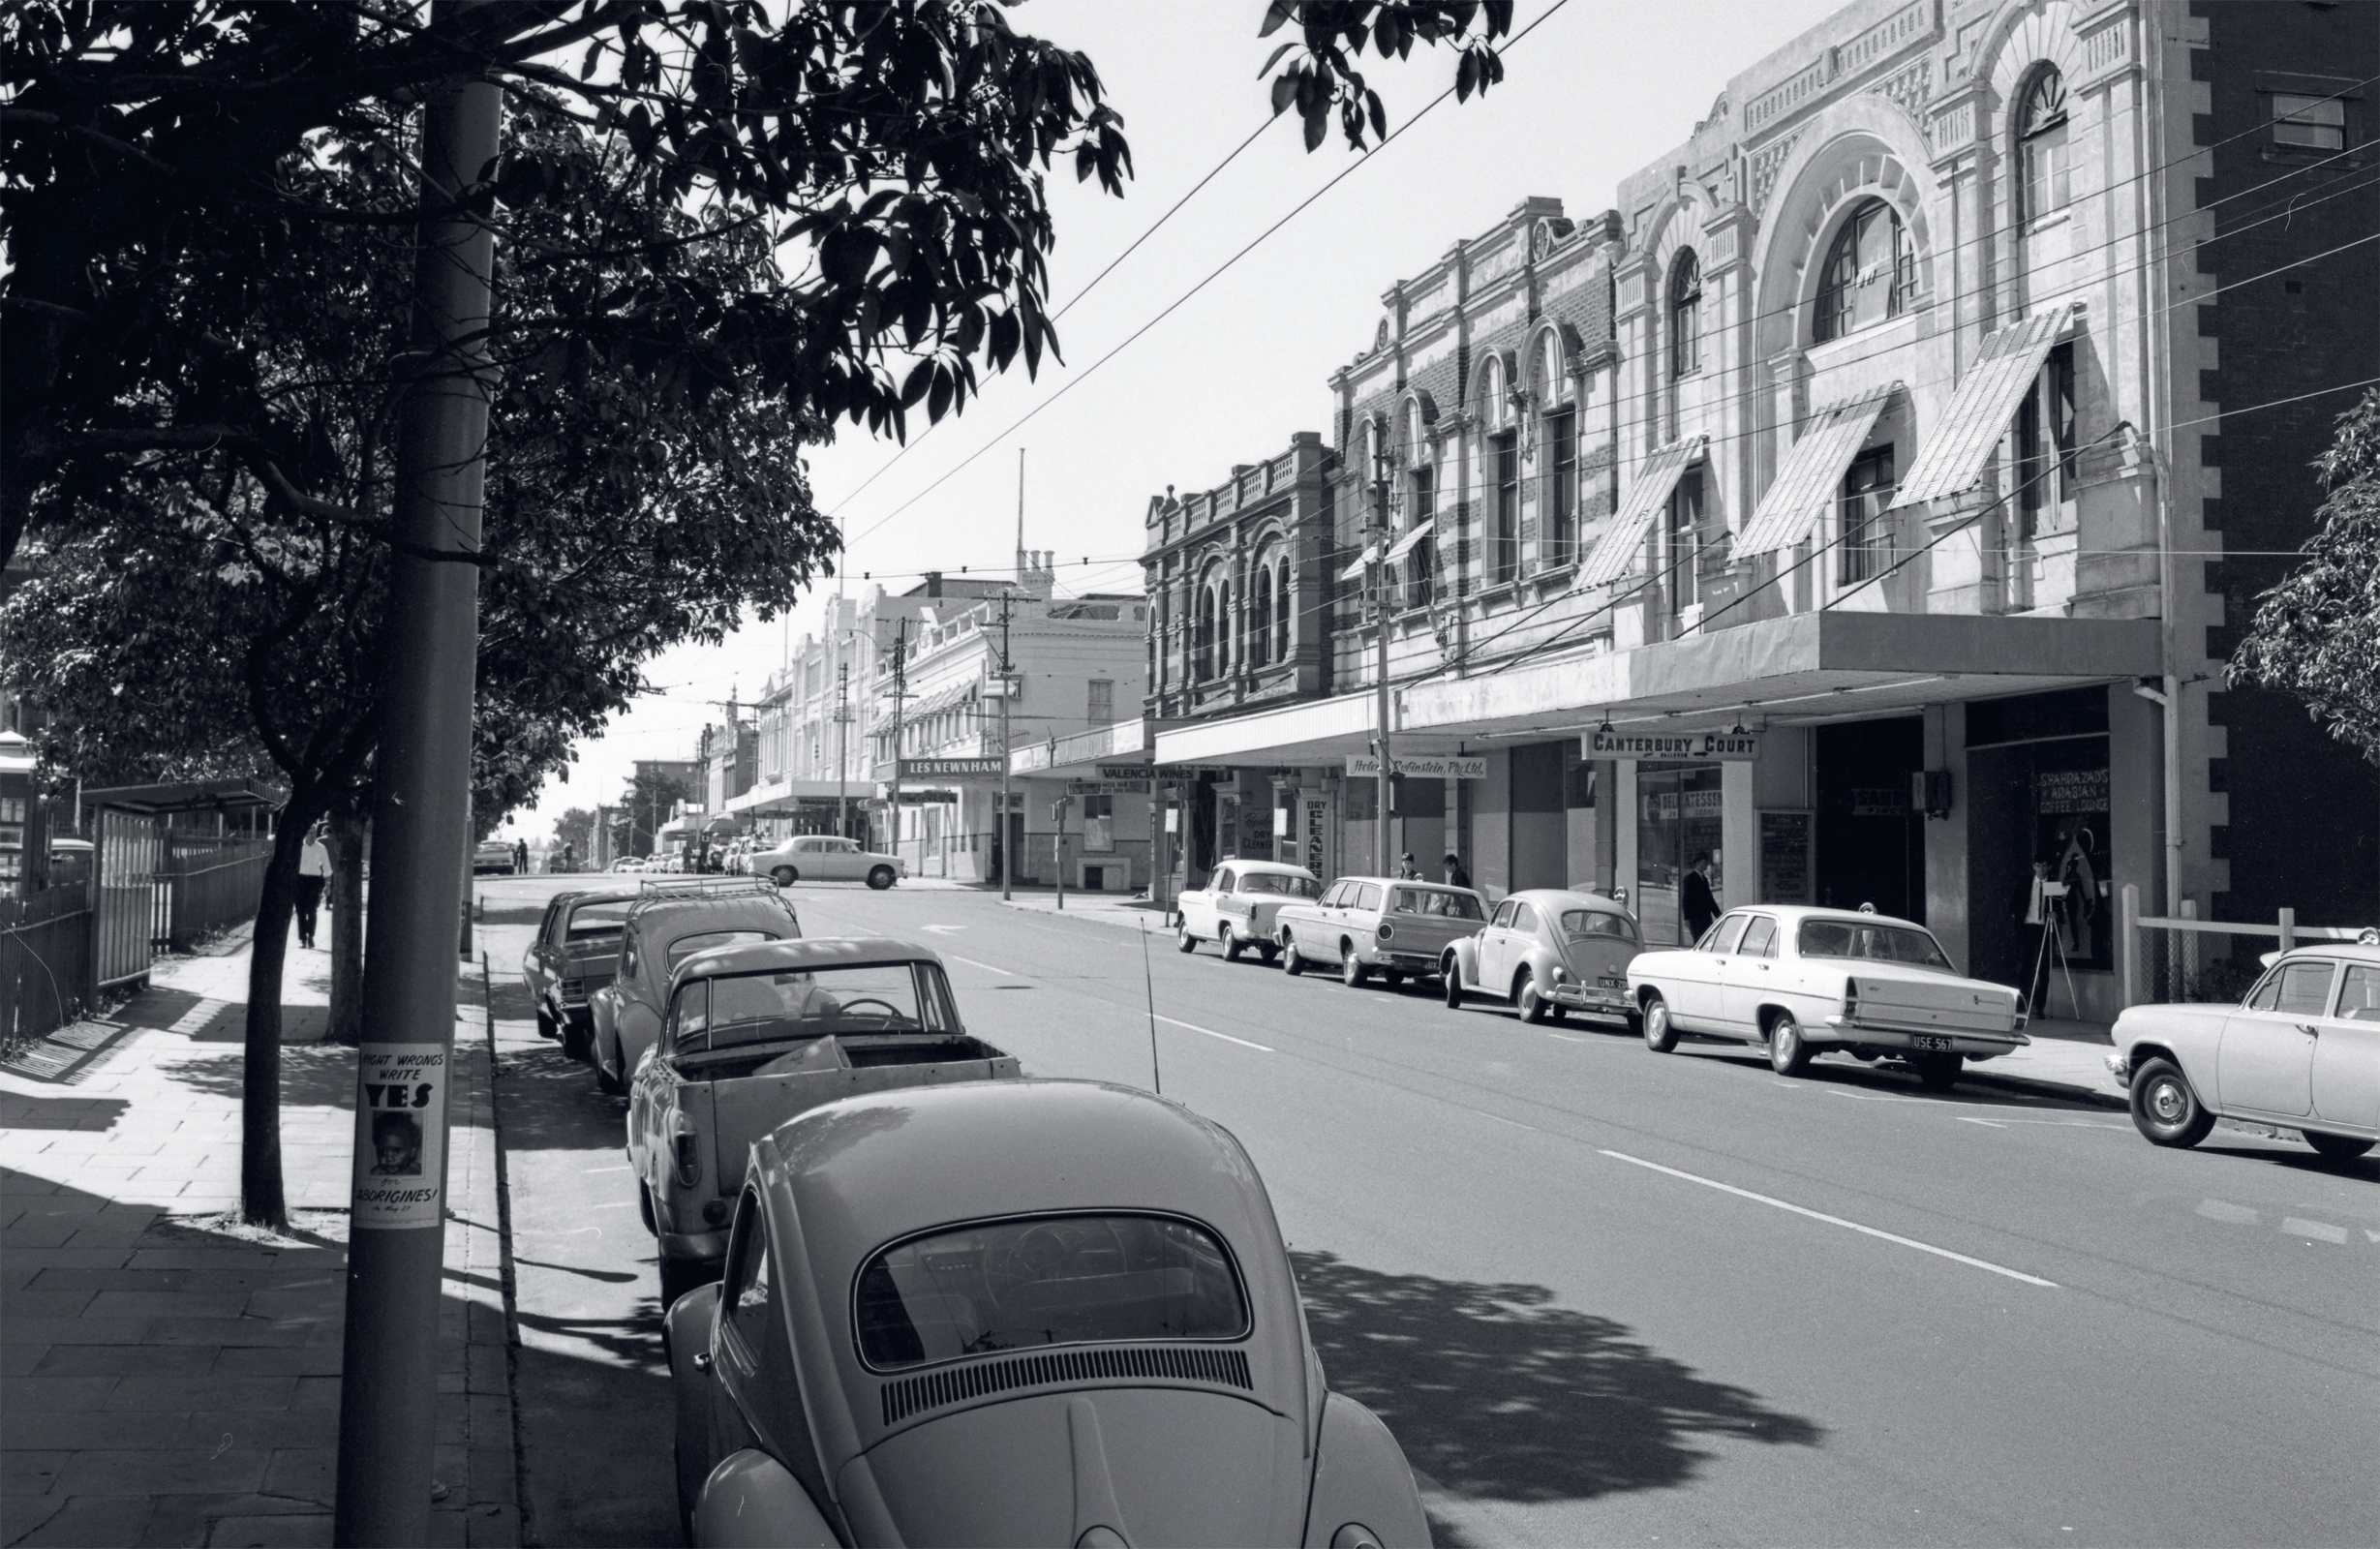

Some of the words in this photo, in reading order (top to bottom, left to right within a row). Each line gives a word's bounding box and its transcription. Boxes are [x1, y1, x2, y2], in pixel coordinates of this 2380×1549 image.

[1593, 733, 1693, 751] CANTERBURY
[1704, 735, 1755, 753] COURT
[910, 762, 931, 774] LES
[933, 761, 1002, 774] NEWNHAM
[1102, 768, 1156, 779] VALENCIA
[1158, 769, 1194, 779] WINES
[2051, 785, 2097, 800] ARABIAN
[1307, 801, 1327, 809] DRY
[2039, 800, 2071, 814] COFFEE
[2076, 798, 2109, 812] LOUNGE
[1254, 831, 1272, 839] DRY
[1309, 809, 1323, 879] CLEANERS
[362, 1053, 392, 1066] RIGHT
[397, 1053, 444, 1066] WRONGS
[379, 1069, 422, 1080] WRITE
[364, 1082, 434, 1109] YES
[355, 1188, 439, 1203] ABORIGINES!
